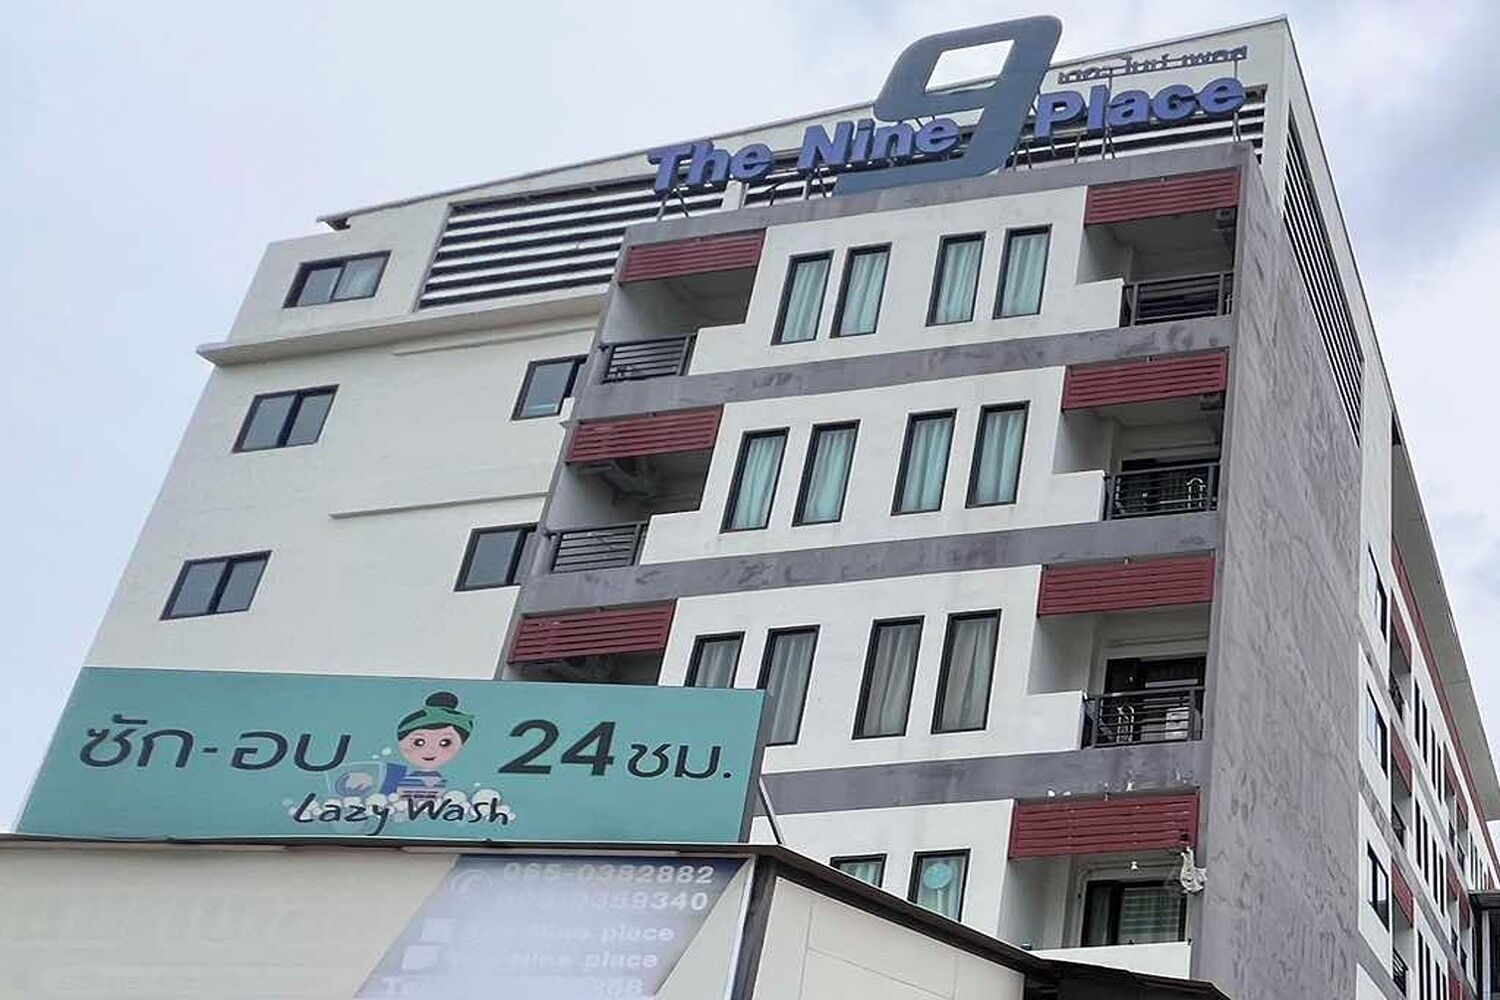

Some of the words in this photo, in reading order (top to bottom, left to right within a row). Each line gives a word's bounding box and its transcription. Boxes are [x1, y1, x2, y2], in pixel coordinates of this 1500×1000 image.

[647, 139, 776, 194] The
[797, 116, 963, 168] Nine
[1033, 77, 1248, 139] Place
[498, 719, 616, 776] 24
[293, 792, 390, 836] Lazy
[406, 797, 509, 825] Wash
[503, 862, 715, 884] 065-0382882
